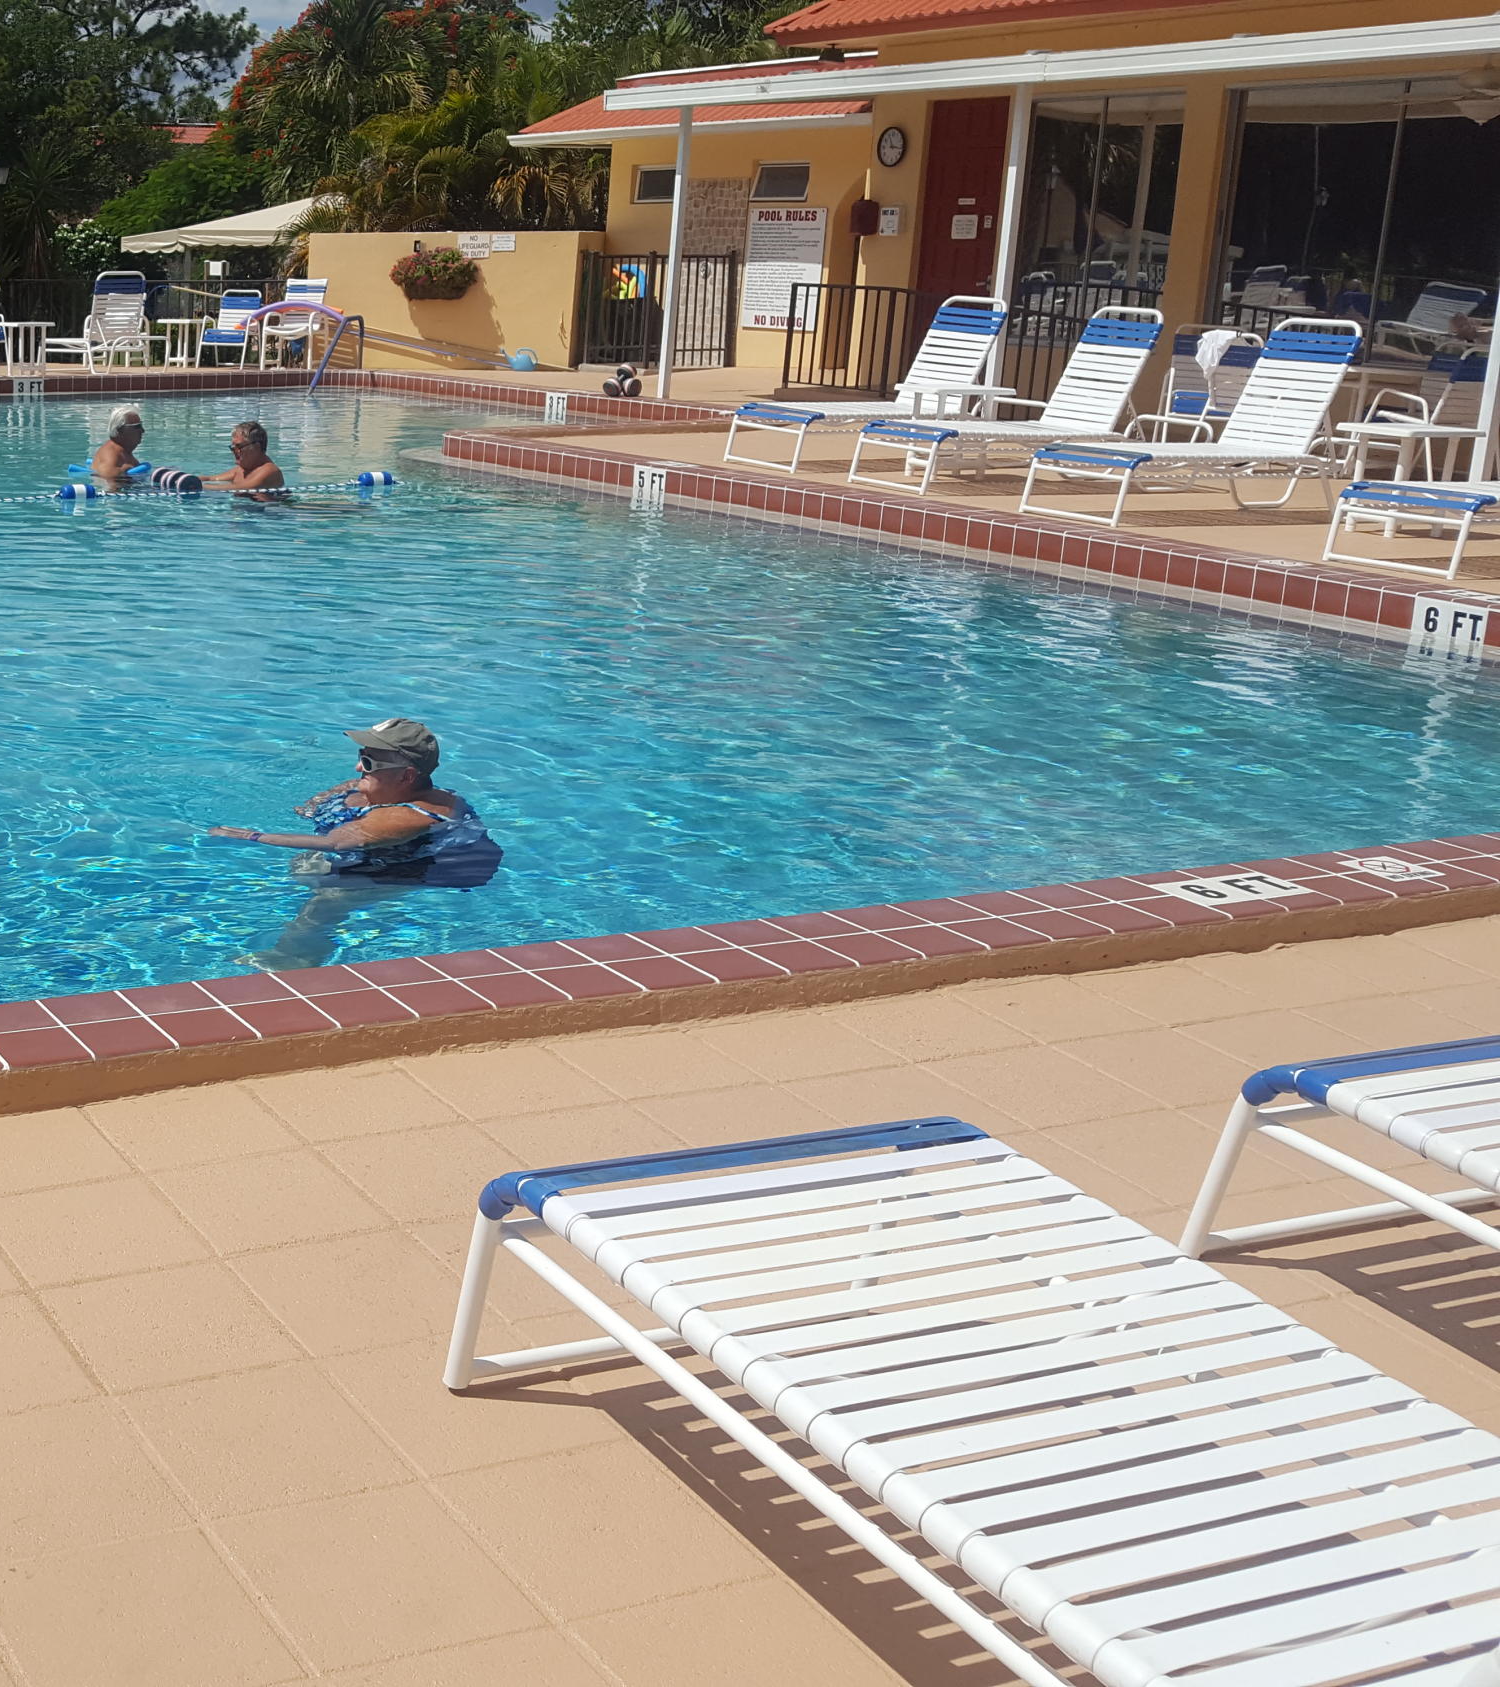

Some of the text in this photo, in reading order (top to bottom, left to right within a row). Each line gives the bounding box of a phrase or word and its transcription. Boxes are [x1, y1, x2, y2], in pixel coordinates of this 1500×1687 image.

[758, 210, 818, 221] POOL RULES
[754, 315, 766, 325] NO
[17, 381, 24, 393] 3
[638, 471, 645, 488] 5
[1424, 606, 1440, 633] 6
[1180, 884, 1228, 899] 6
